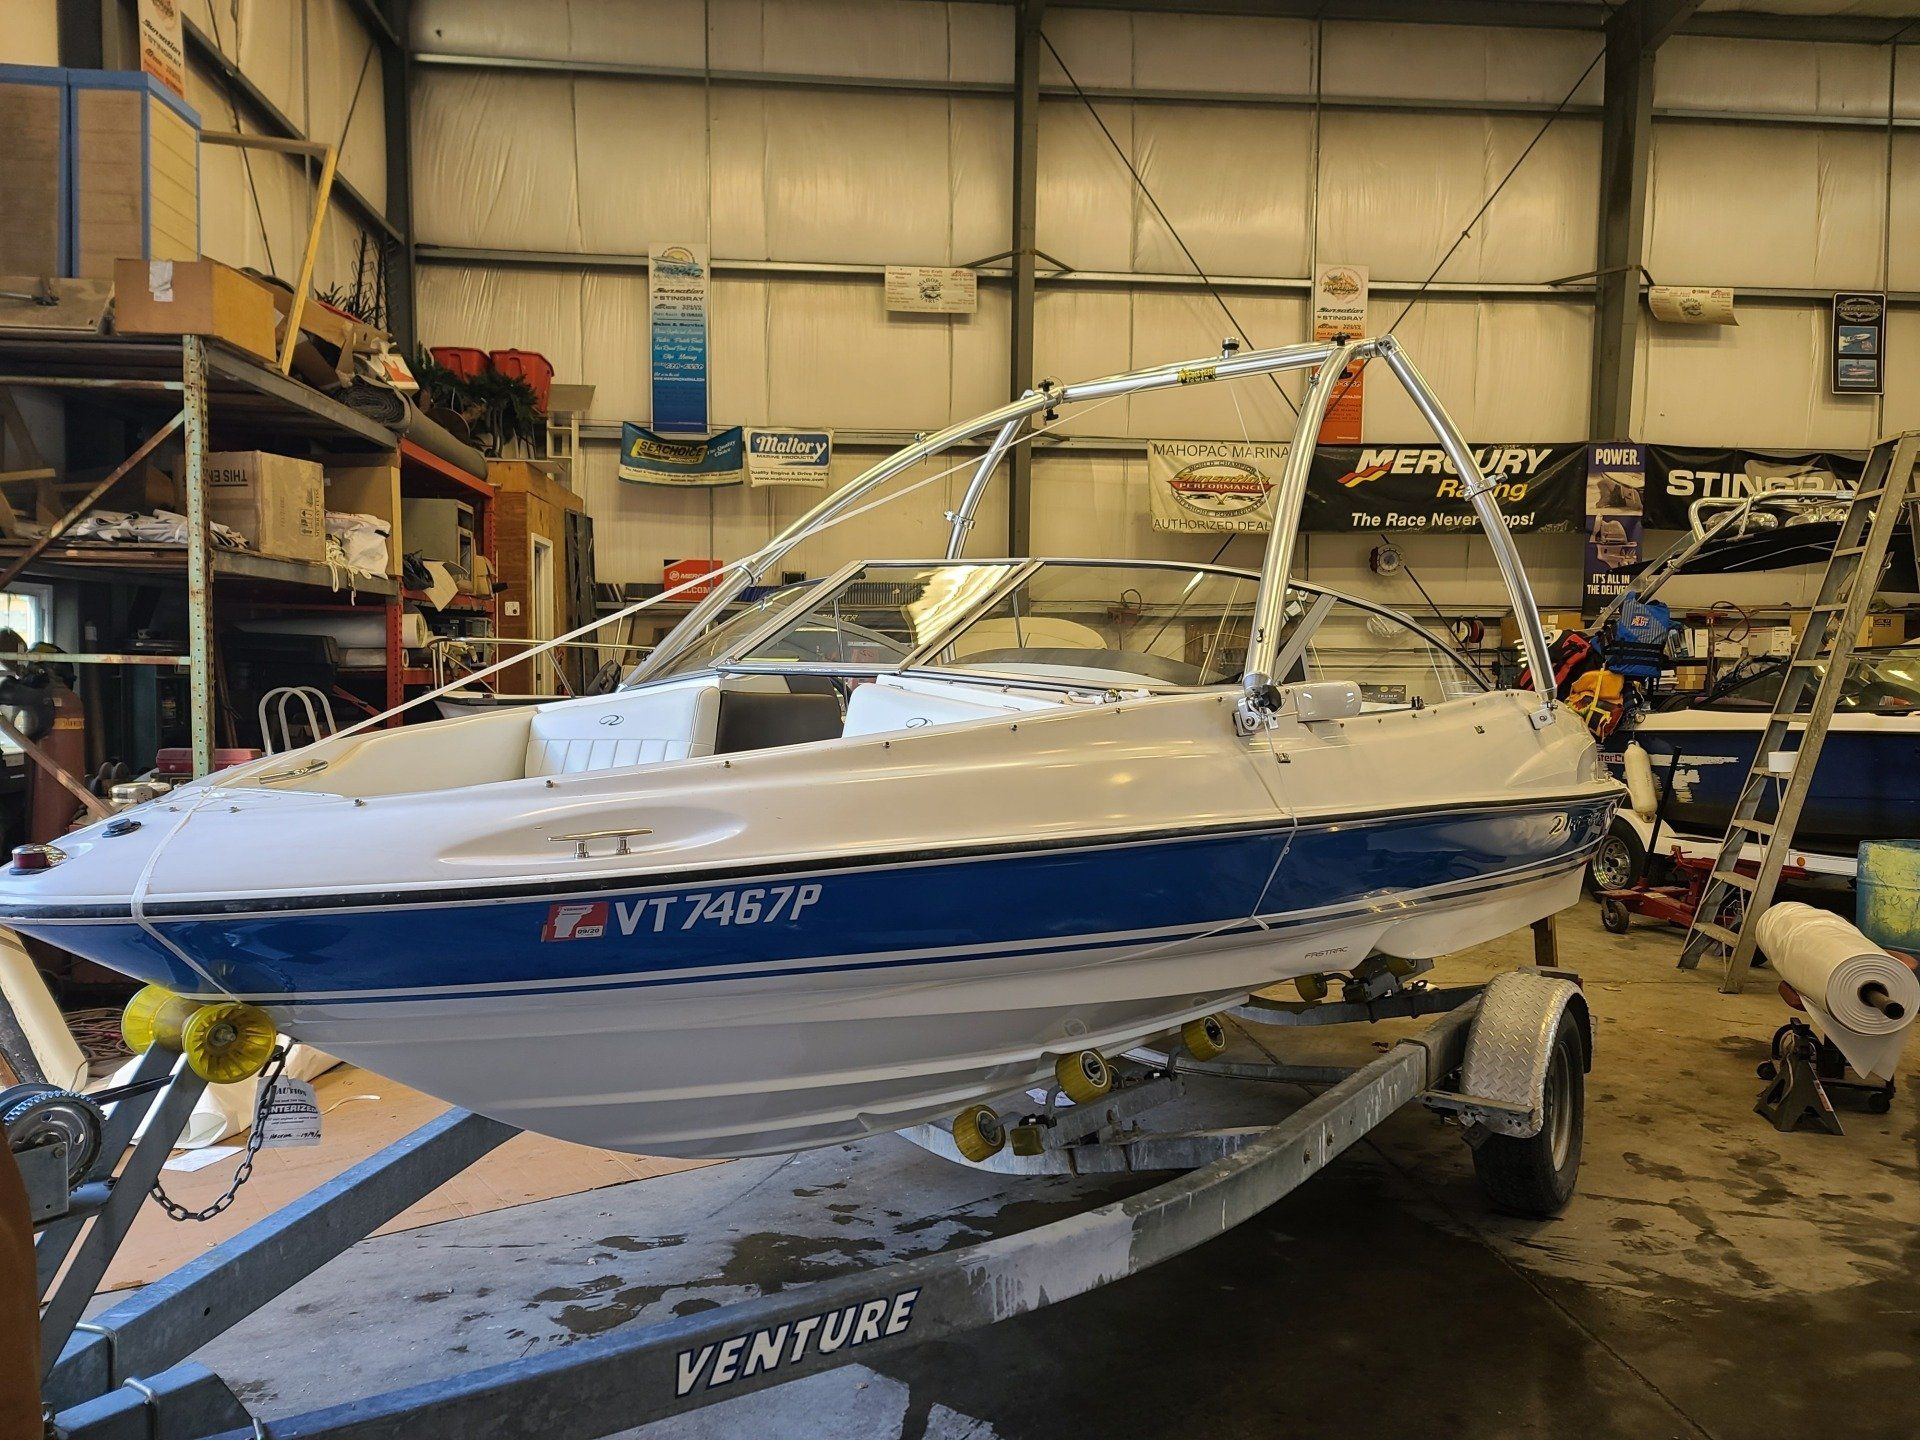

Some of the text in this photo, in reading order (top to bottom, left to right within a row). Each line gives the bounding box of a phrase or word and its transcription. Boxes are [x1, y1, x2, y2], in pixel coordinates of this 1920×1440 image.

[639, 441, 704, 457] SEACHOICE
[714, 448, 731, 457] Choice
[717, 441, 736, 451] Quality
[756, 436, 827, 463] Mallory
[1153, 443, 1289, 458] MAHOPAC MARINA
[1596, 449, 1640, 465] POWER.
[208, 470, 247, 482] THIS EN
[1179, 483, 1264, 491] PERFORMANCE
[1437, 479, 1528, 501] Rang
[1154, 519, 1271, 532] AUTHORIZED DEAL
[1351, 512, 1535, 528] The Race Never ops!
[1592, 573, 1630, 584] IT'S ALL IN
[1587, 584, 1626, 594] THE DELIVE
[615, 883, 822, 936] VT 7467P
[1305, 946, 1349, 959] FASTRAC
[276, 1087, 307, 1097] AUTION
[270, 1104, 317, 1113] NTERIZED
[675, 1286, 922, 1398] VENTURE
